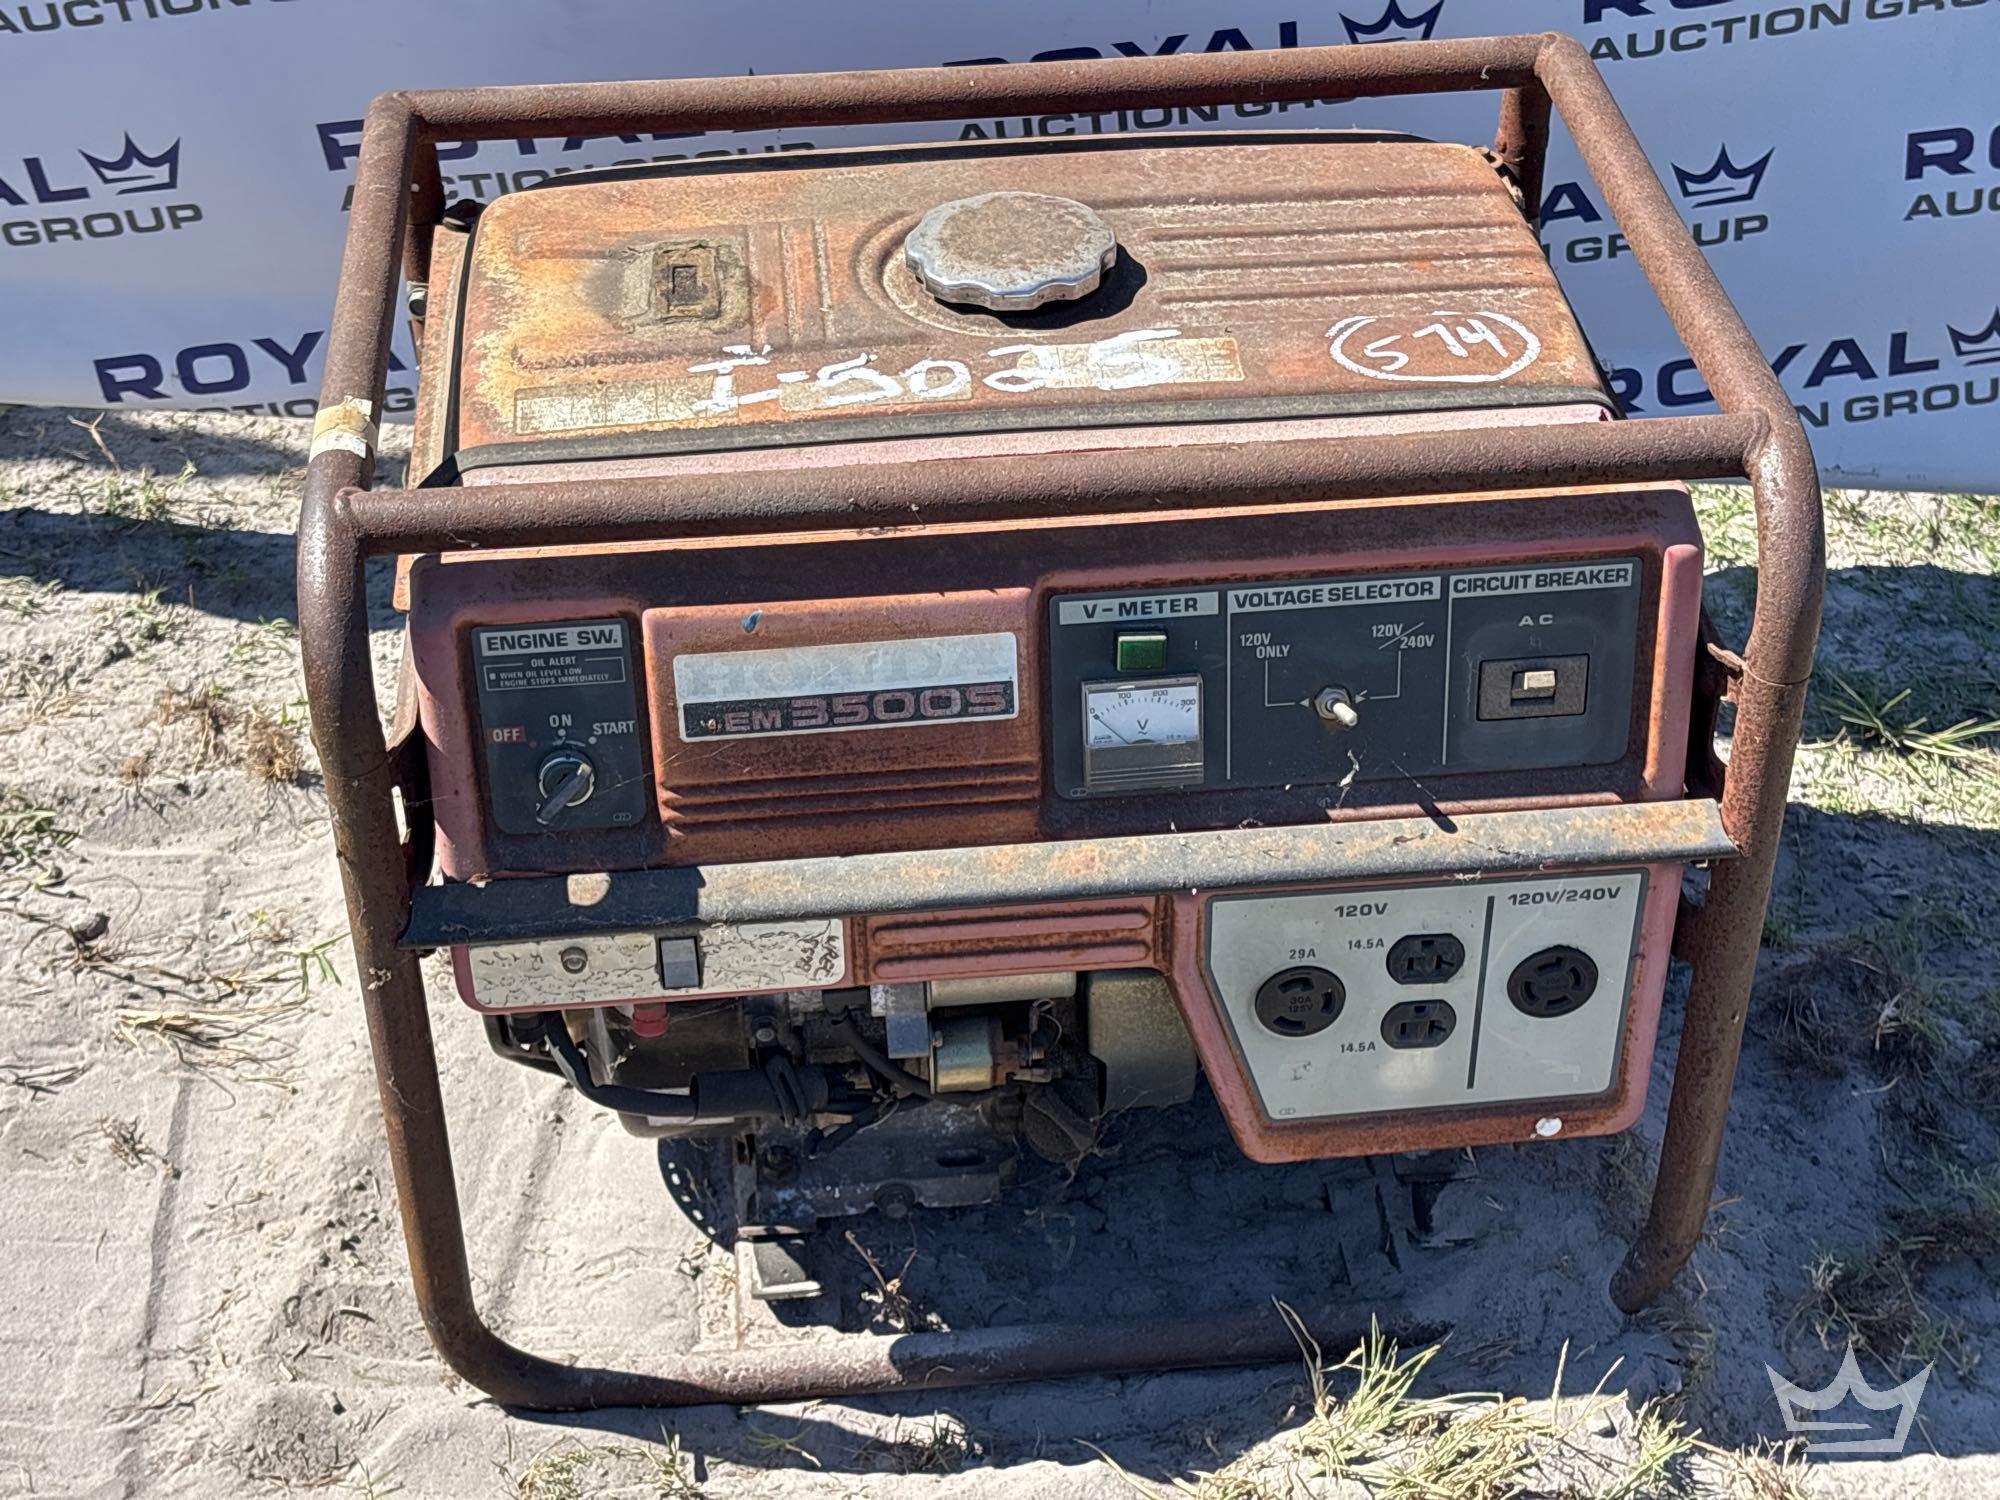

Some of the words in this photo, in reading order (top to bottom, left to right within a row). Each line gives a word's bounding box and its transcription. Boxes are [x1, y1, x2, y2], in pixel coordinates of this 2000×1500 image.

[1589, 1, 1850, 61] AUCTION
[1, 203, 204, 247] GROUP
[1565, 214, 1769, 264] GRUP
[93, 330, 408, 403] ROY
[1453, 573, 1532, 593] CIRCUIT
[1535, 567, 1629, 588] BREAKER
[1234, 588, 1324, 608] VOLTAGE
[1328, 581, 1434, 601] SELECTOR
[486, 632, 568, 651] ENGINE
[577, 629, 618, 645] SW.
[1240, 633, 1271, 647] 120V
[1256, 644, 1290, 658] ONLY
[530, 659, 546, 668] OIL
[549, 656, 577, 667] ALERT
[549, 714, 572, 728] ON
[592, 721, 635, 736] START
[1136, 719, 1149, 731] V
[492, 729, 521, 742] OFF
[1507, 887, 1622, 907] 120V/240V
[1333, 903, 1388, 918] 120V
[1347, 938, 1385, 951] 14.5A
[1289, 948, 1316, 960] 29A
[1340, 1042, 1377, 1054] 14.5A
